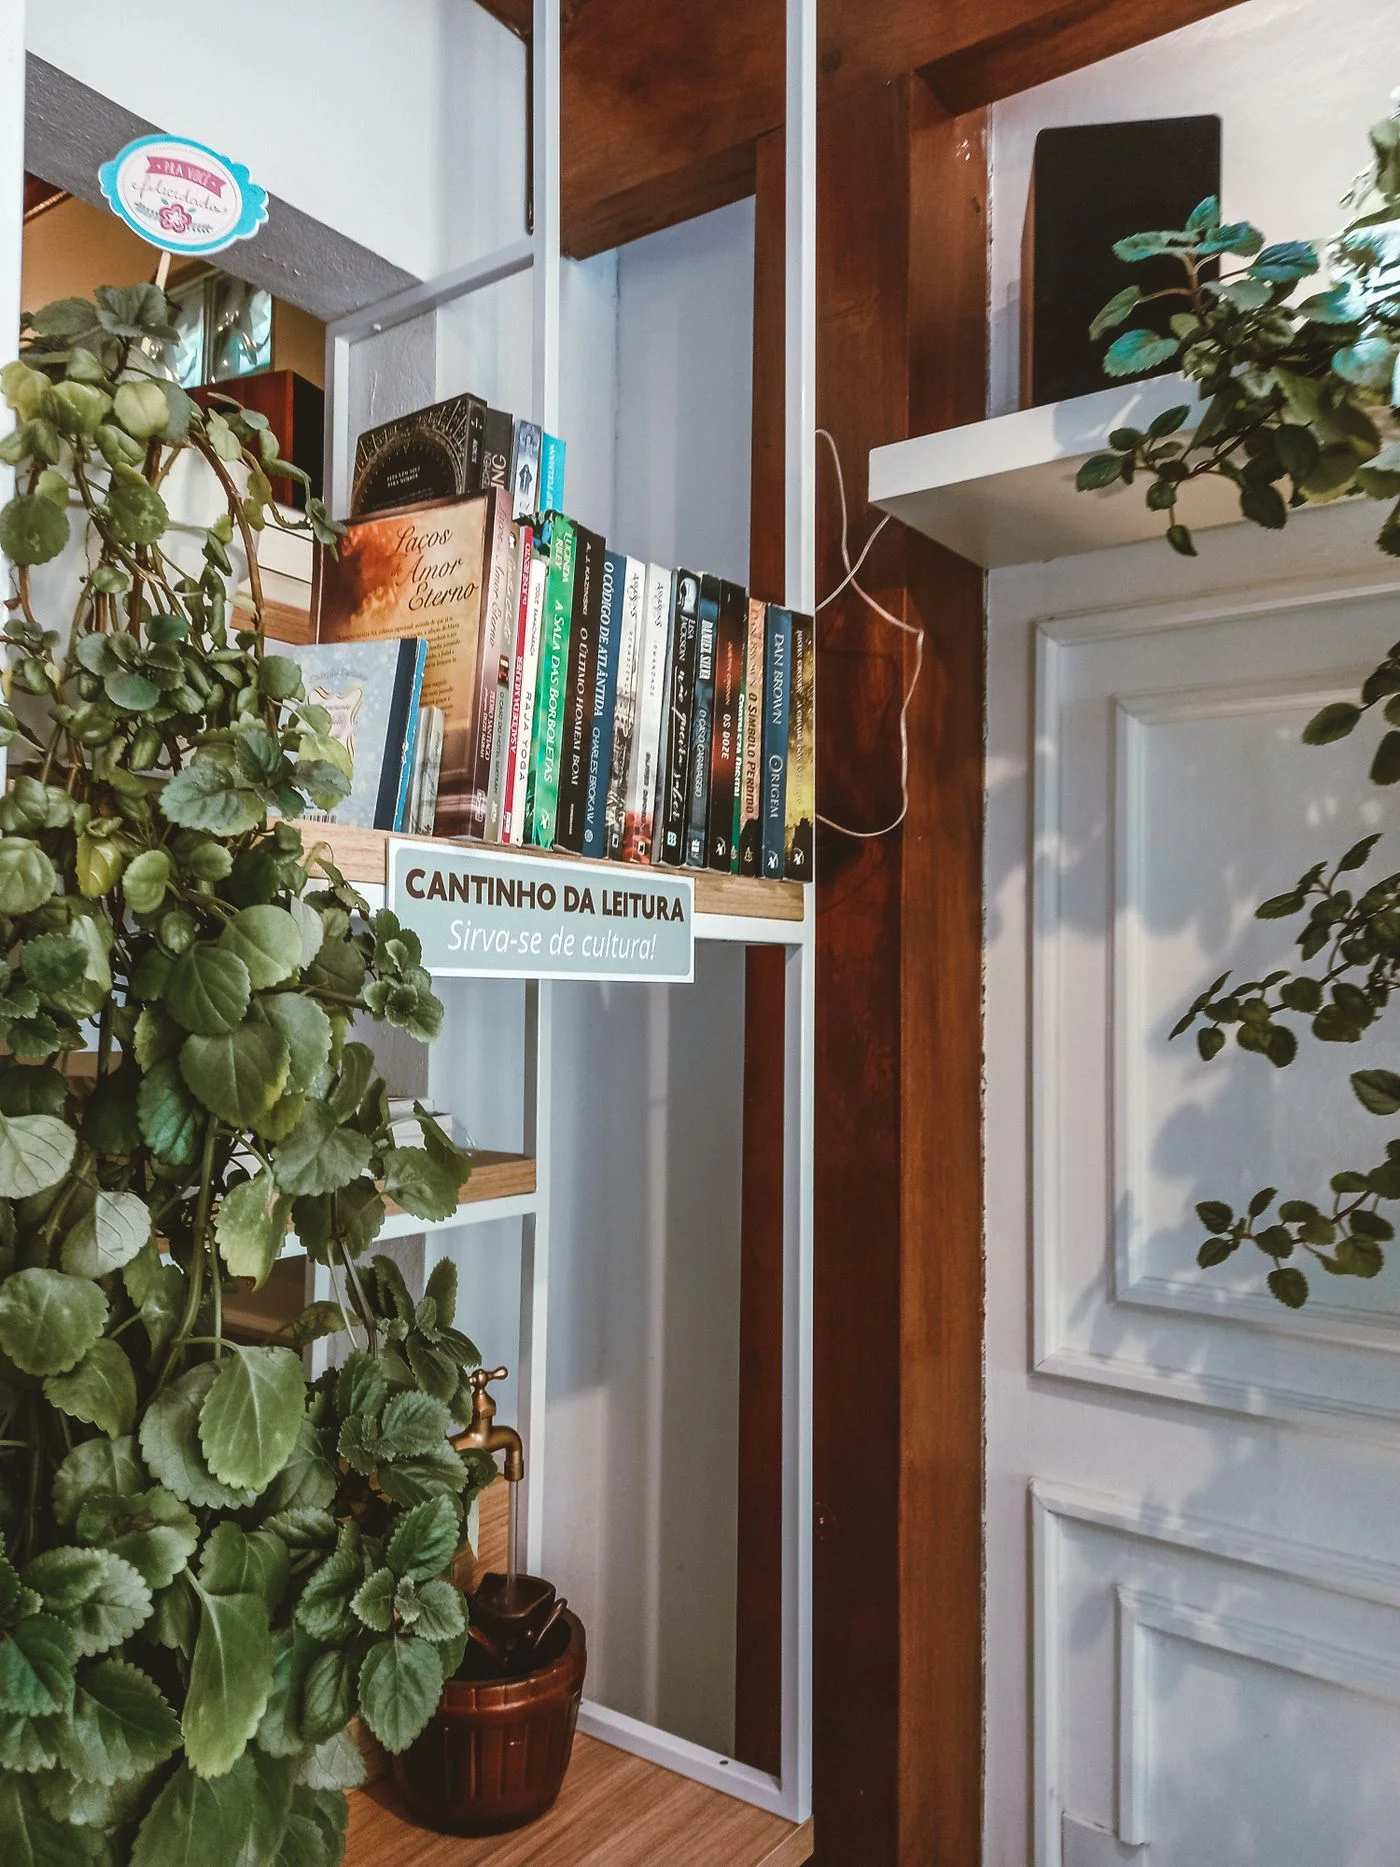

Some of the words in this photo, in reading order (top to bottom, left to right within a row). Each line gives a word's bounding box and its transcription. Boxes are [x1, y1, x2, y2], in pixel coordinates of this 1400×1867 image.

[163, 160, 184, 177] PRA
[491, 454, 506, 489] ING
[394, 526, 453, 555] Laços
[554, 537, 564, 570] RILEY
[562, 531, 573, 583] LUCINDA
[586, 542, 592, 553] A.
[397, 558, 464, 587] Amor
[492, 554, 504, 600] Amor
[585, 555, 591, 564] J.
[603, 561, 614, 573] O
[408, 581, 480, 612] Eterno
[554, 599, 563, 611] A
[582, 566, 591, 616] KAZINSKI
[600, 574, 614, 625] CÓDIGO
[489, 601, 502, 648] Eterno
[552, 613, 564, 650] SALA
[580, 627, 588, 641] O
[598, 626, 609, 644] DE
[678, 614, 688, 662] JACKSON
[687, 619, 696, 639] LISA
[700, 619, 713, 654] DANIEL
[774, 633, 785, 665] DAN
[514, 656, 523, 696] MULHER
[550, 655, 560, 684] DAS
[576, 643, 588, 694] ÚLTIMO
[594, 646, 609, 717] ATLÂNTIDA
[699, 654, 712, 680] SILVA
[513, 697, 520, 711] DA
[677, 669, 688, 704] não
[748, 692, 758, 701] O
[772, 670, 784, 725] BROWN
[487, 691, 496, 718] PEDRO
[523, 691, 532, 731] RAJA
[699, 709, 706, 717] O
[722, 713, 732, 727] OS
[485, 720, 494, 761] SANTIAGO
[497, 721, 503, 733] DO
[544, 687, 559, 783] BORBOLETAS
[573, 697, 584, 750] HOMEM
[671, 706, 688, 767] queira
[698, 718, 706, 742] CASO
[746, 704, 757, 757] SÍMBOLO
[510, 745, 517, 753] A
[519, 739, 529, 782] YOGA
[590, 727, 601, 774] CHARLES
[721, 731, 731, 760] DOZE
[570, 754, 580, 786] BOM
[694, 743, 704, 797] CARAVAGGIO
[745, 760, 756, 813] PERDIDO
[769, 754, 783, 818] ORIGEM
[586, 775, 598, 825] BROKAW
[672, 769, 684, 822] saber
[405, 868, 556, 911] CANTINHO
[563, 885, 595, 914] DA
[602, 890, 685, 922] LEITURA
[448, 919, 542, 954] Sirva-se
[550, 925, 575, 957] de
[582, 929, 657, 961] cultura!
